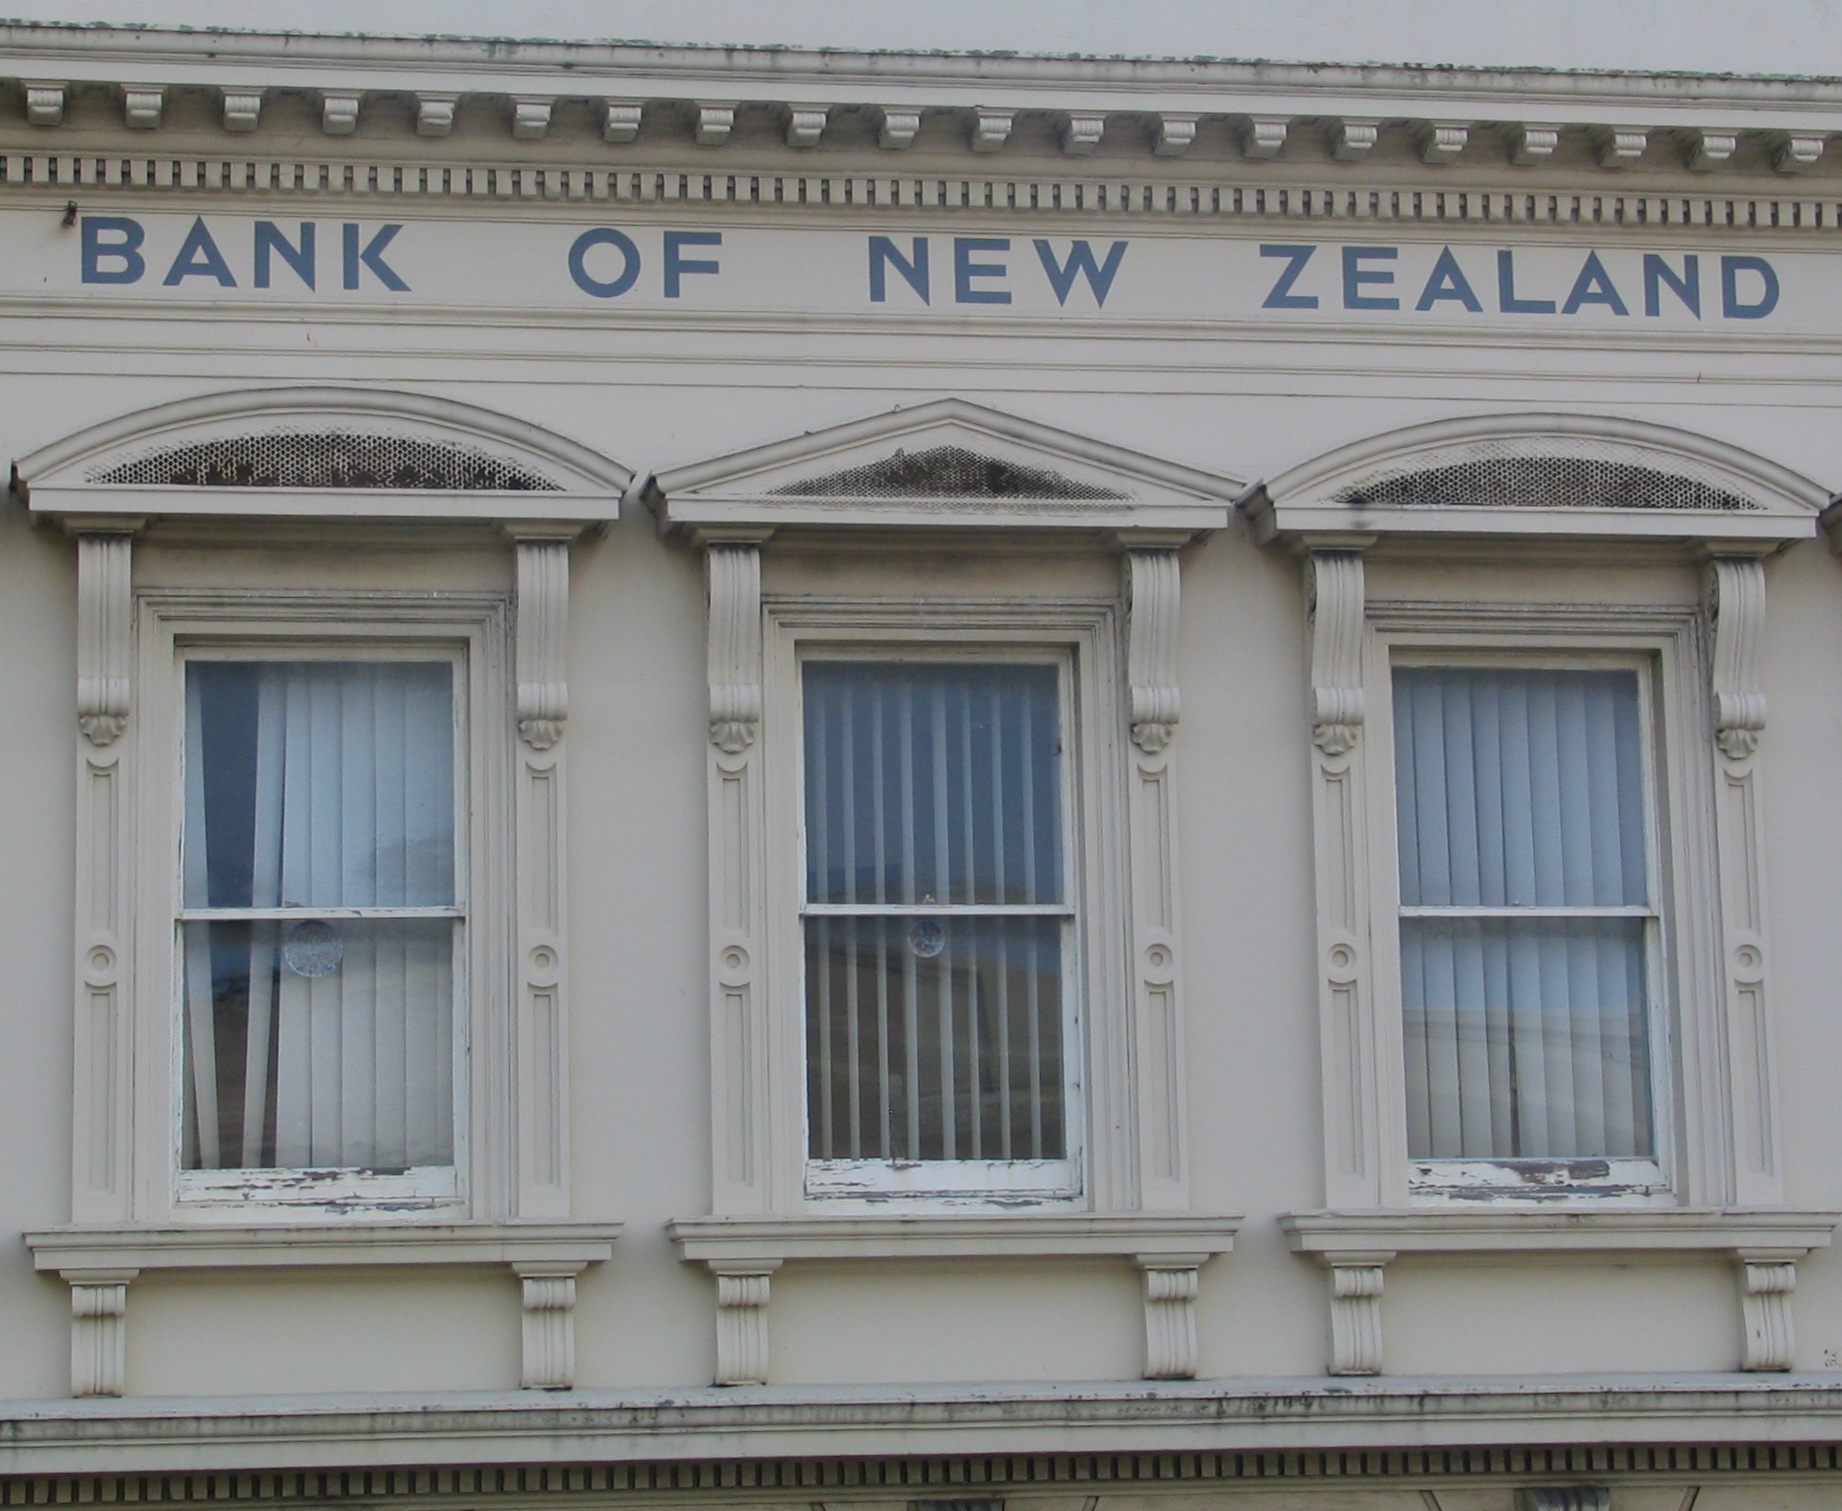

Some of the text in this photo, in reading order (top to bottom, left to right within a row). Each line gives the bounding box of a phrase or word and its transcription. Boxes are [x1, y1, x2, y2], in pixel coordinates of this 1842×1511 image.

[81, 216, 1780, 320] BANK OF NEW ZEALAND
